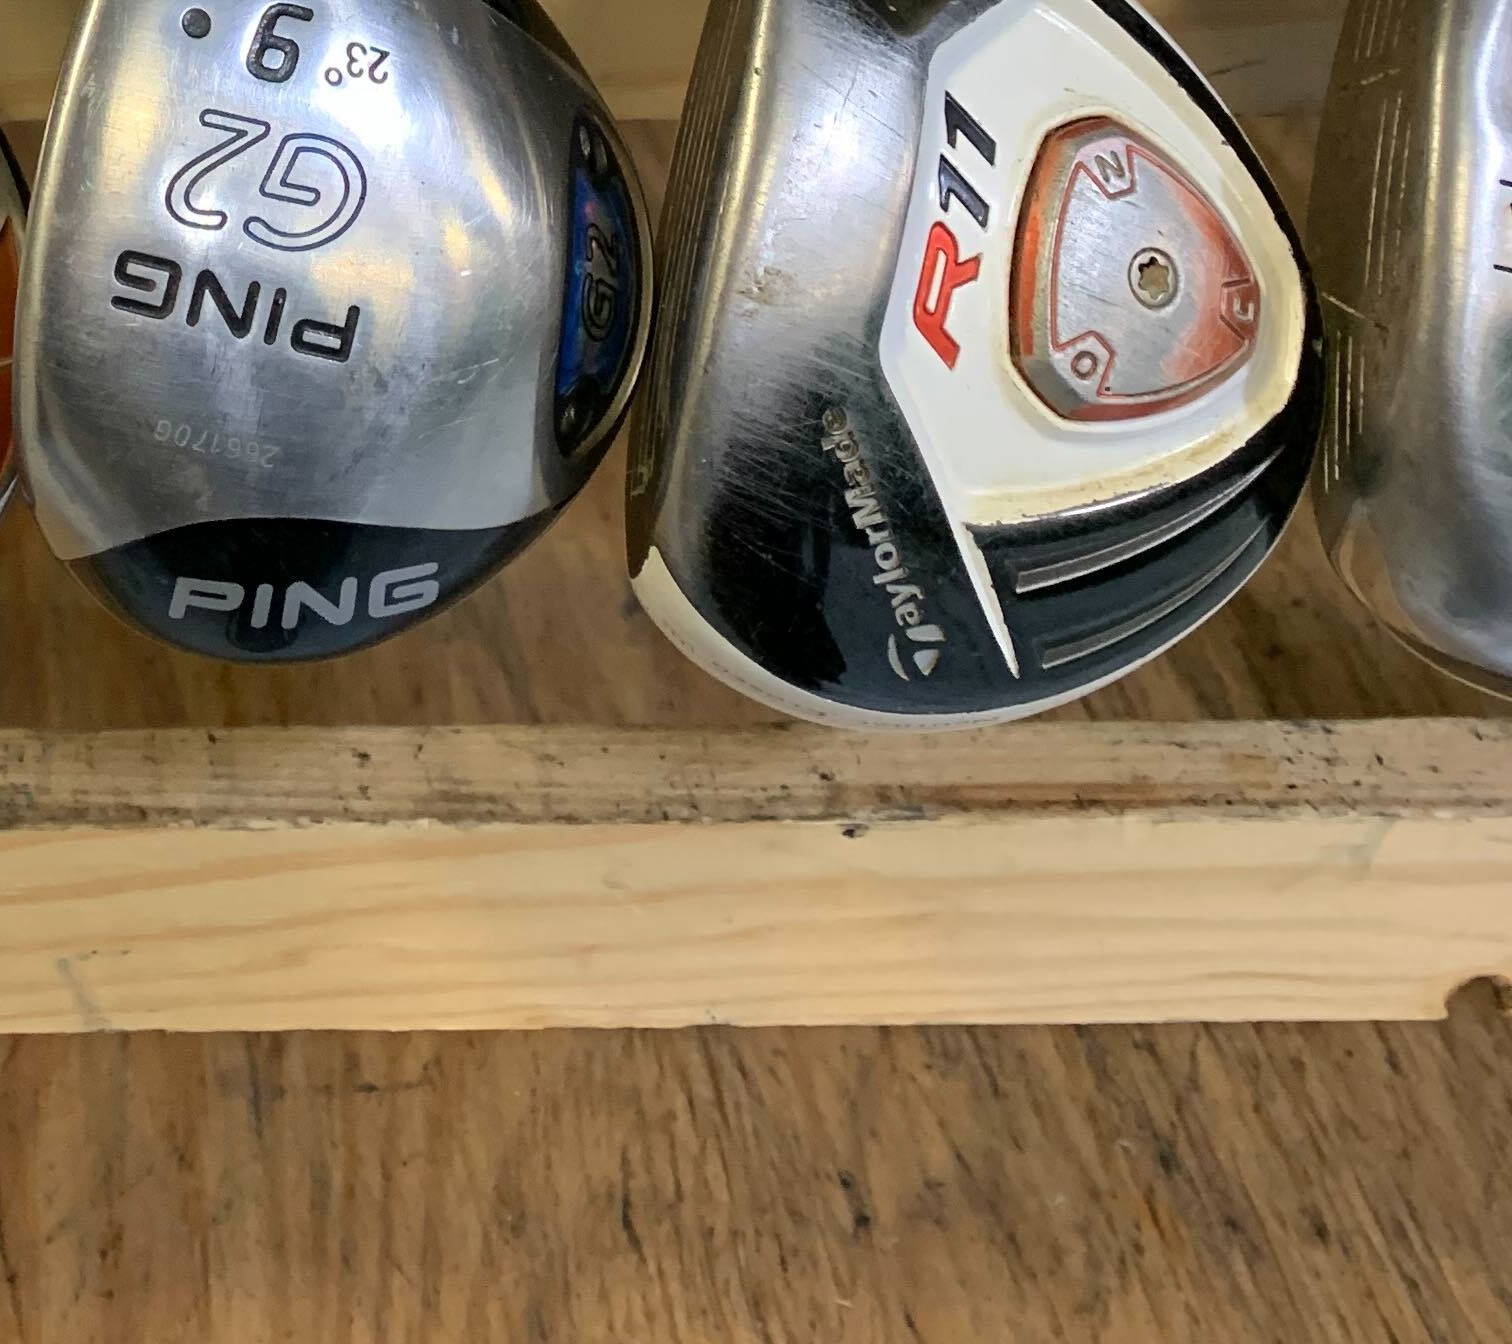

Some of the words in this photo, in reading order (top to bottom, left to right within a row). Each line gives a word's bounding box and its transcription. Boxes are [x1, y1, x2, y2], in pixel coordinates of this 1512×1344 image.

[164, 108, 369, 253] G2
[911, 91, 999, 372] R11
[111, 249, 360, 364] PING
[579, 222, 620, 344] G2
[168, 562, 439, 630] PING
